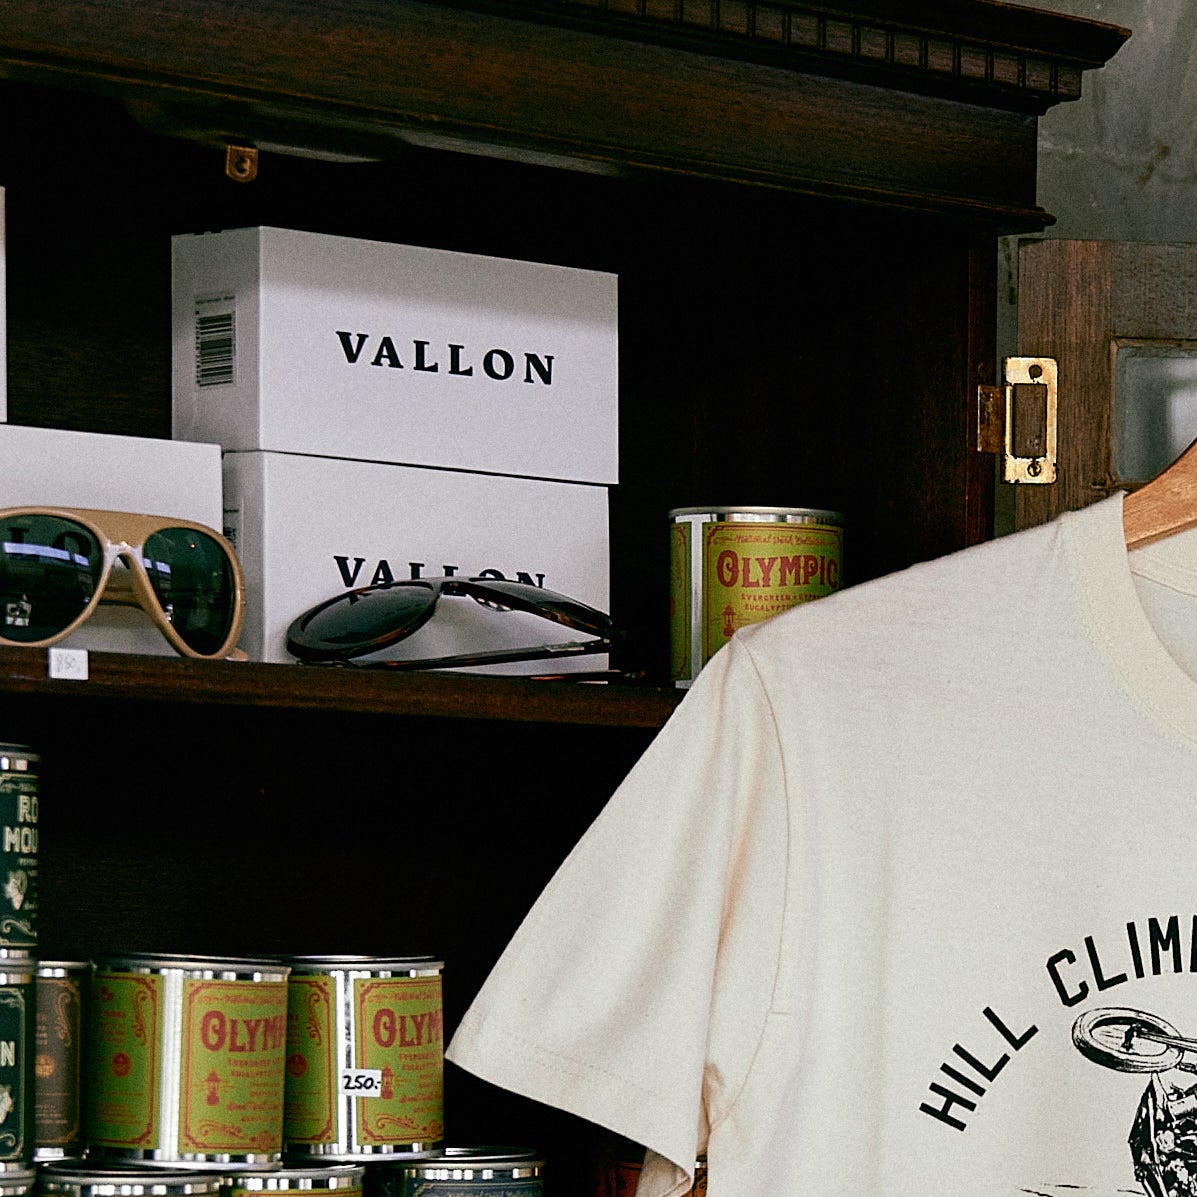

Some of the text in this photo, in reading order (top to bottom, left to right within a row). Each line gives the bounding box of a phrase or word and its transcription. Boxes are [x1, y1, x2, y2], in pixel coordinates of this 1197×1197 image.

[335, 330, 555, 386] VALLON
[716, 549, 839, 589] OLYMPIC
[201, 1009, 287, 1052] OLYM
[919, 1006, 1039, 1132] HILL
